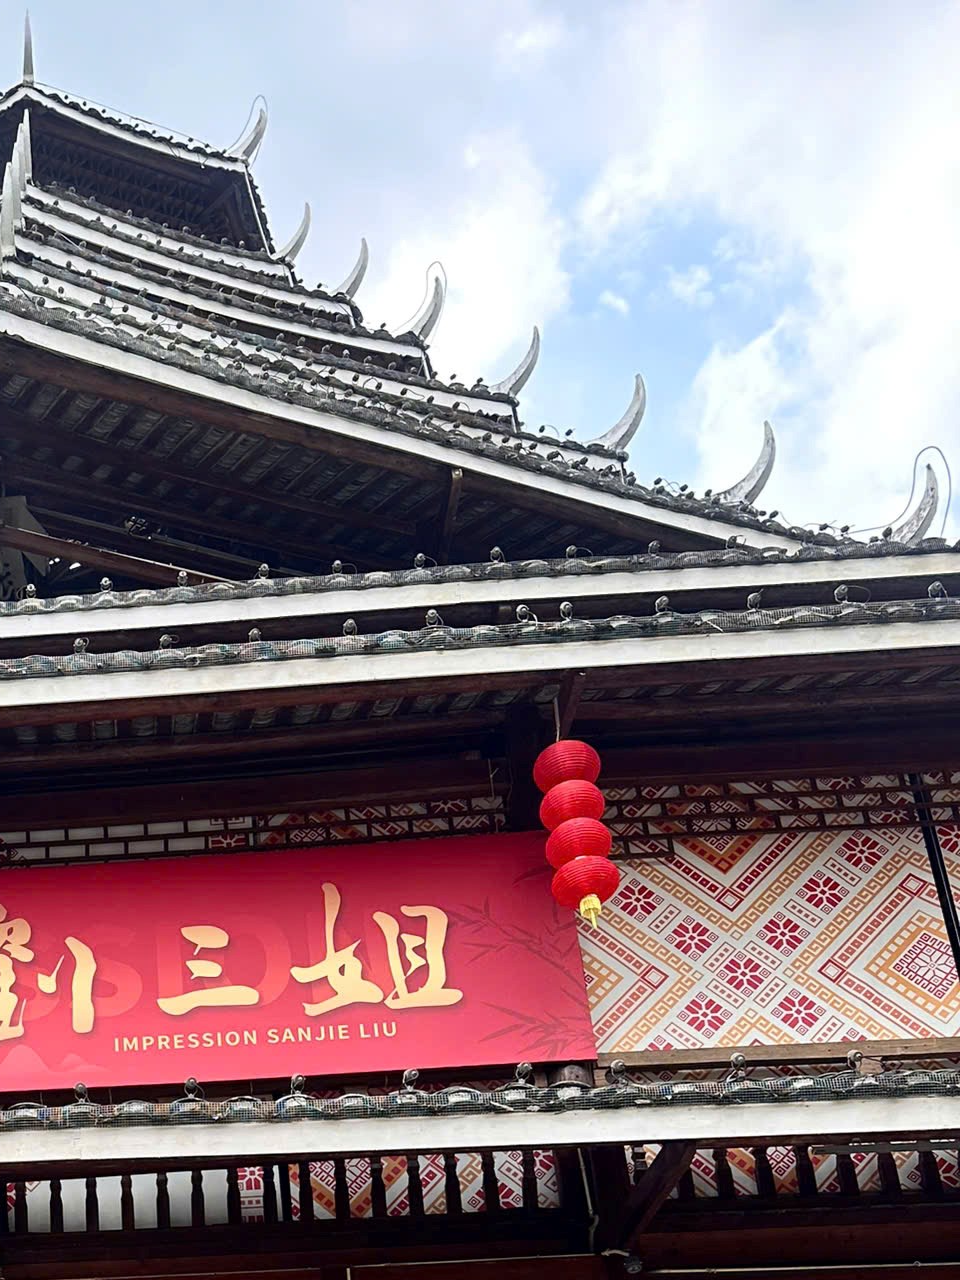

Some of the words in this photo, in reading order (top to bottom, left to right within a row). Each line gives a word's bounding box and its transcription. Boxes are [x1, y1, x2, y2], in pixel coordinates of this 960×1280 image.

[114, 1030, 257, 1052] IMPRESSION
[267, 1024, 350, 1044] SANJIE
[359, 1022, 398, 1039] LIU
